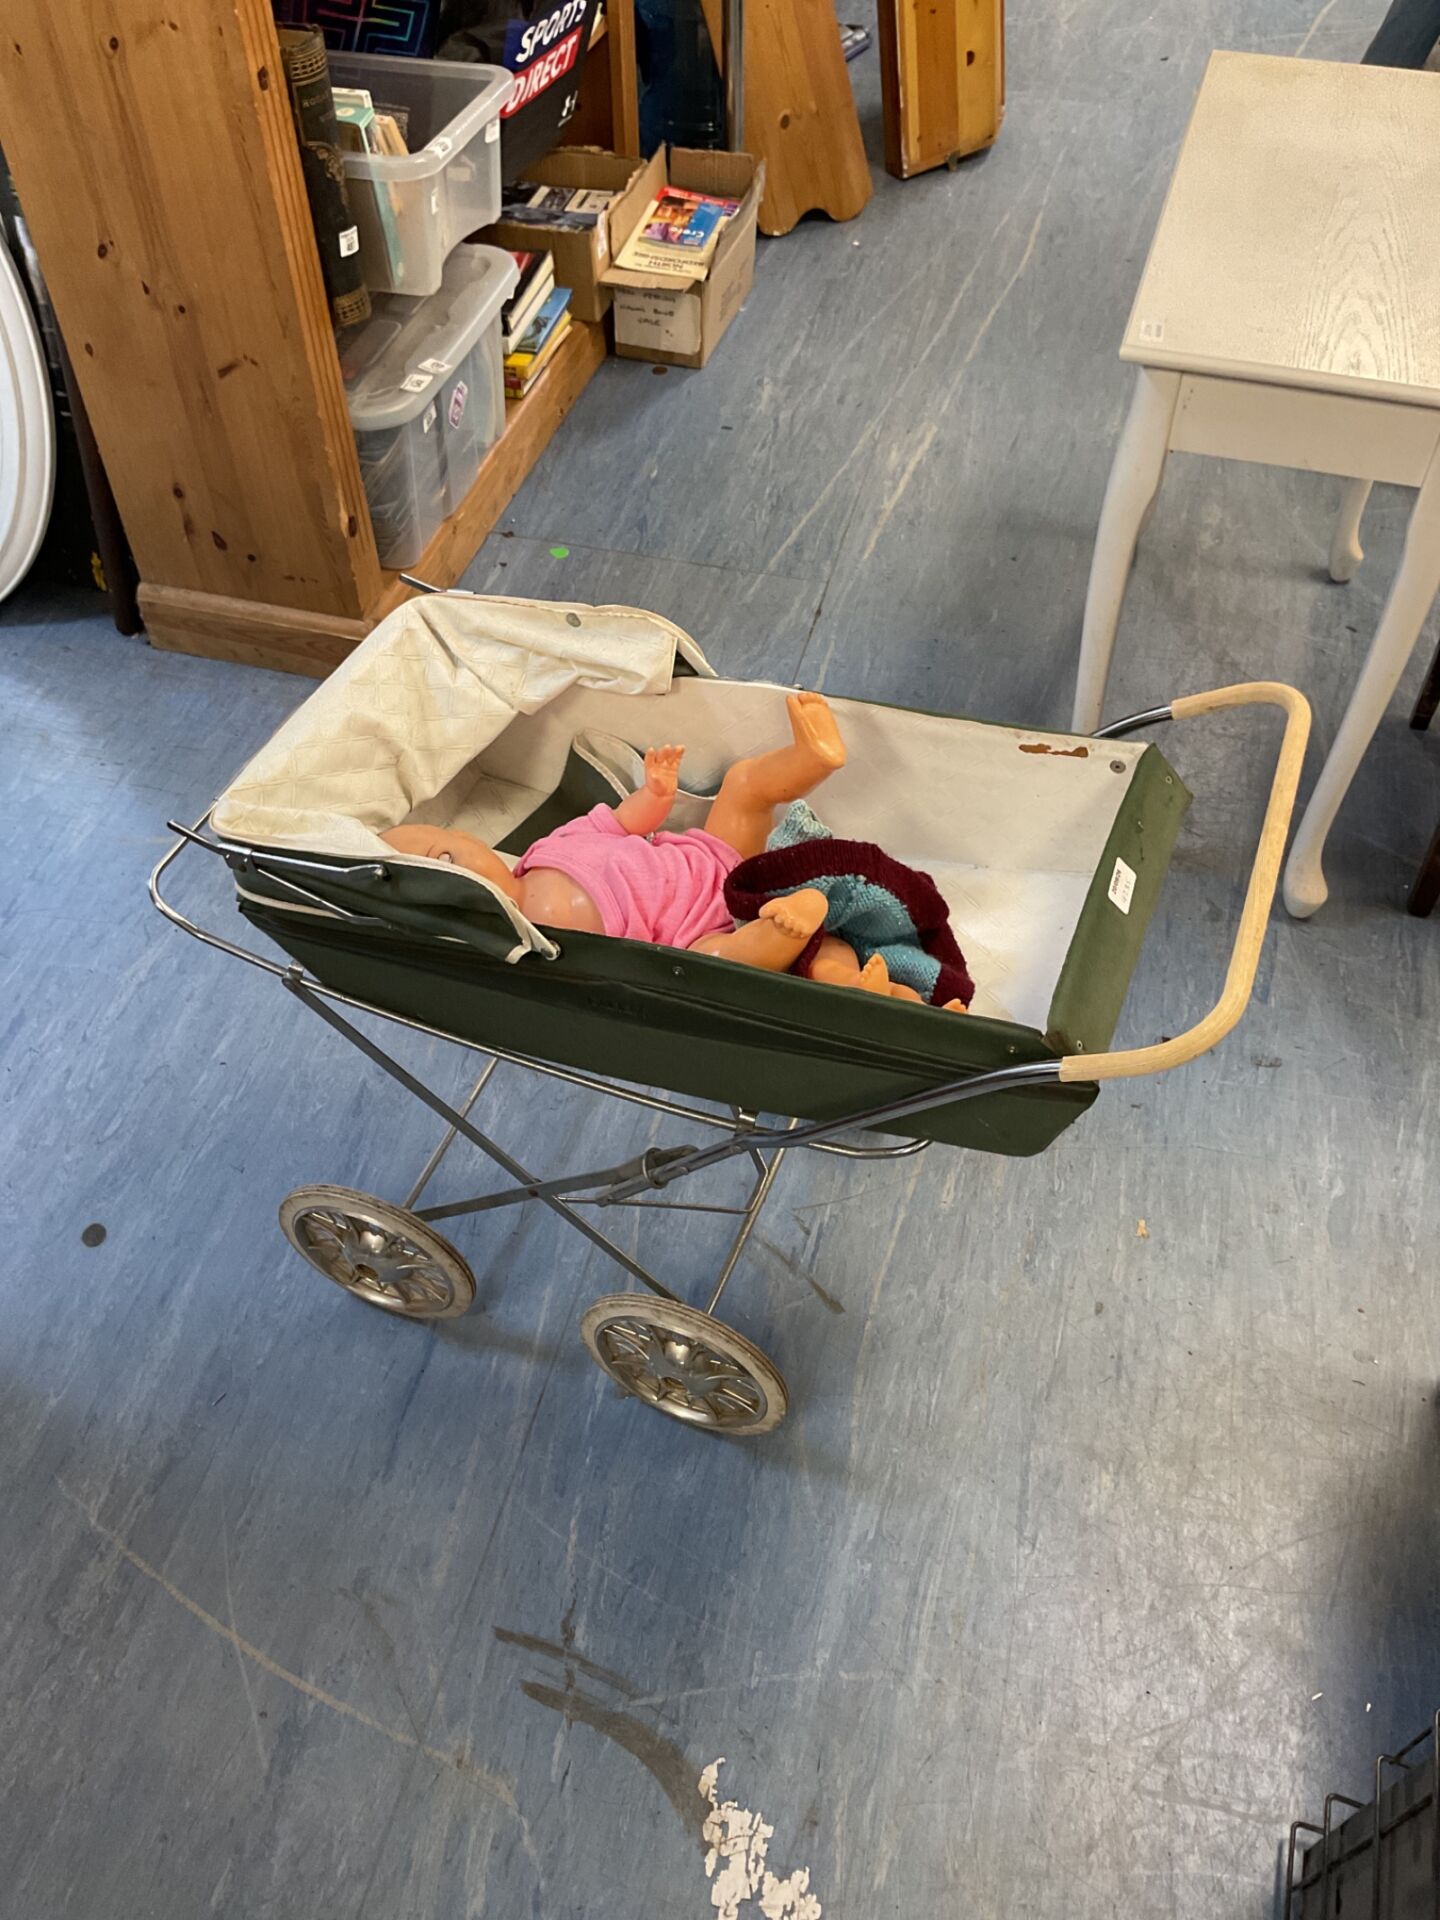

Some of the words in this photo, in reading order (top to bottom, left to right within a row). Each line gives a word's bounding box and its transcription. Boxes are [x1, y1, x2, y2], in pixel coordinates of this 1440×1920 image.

[515, 0, 587, 62] SPORTS
[505, 34, 578, 113] DIRECT
[669, 226, 705, 239] Crete
